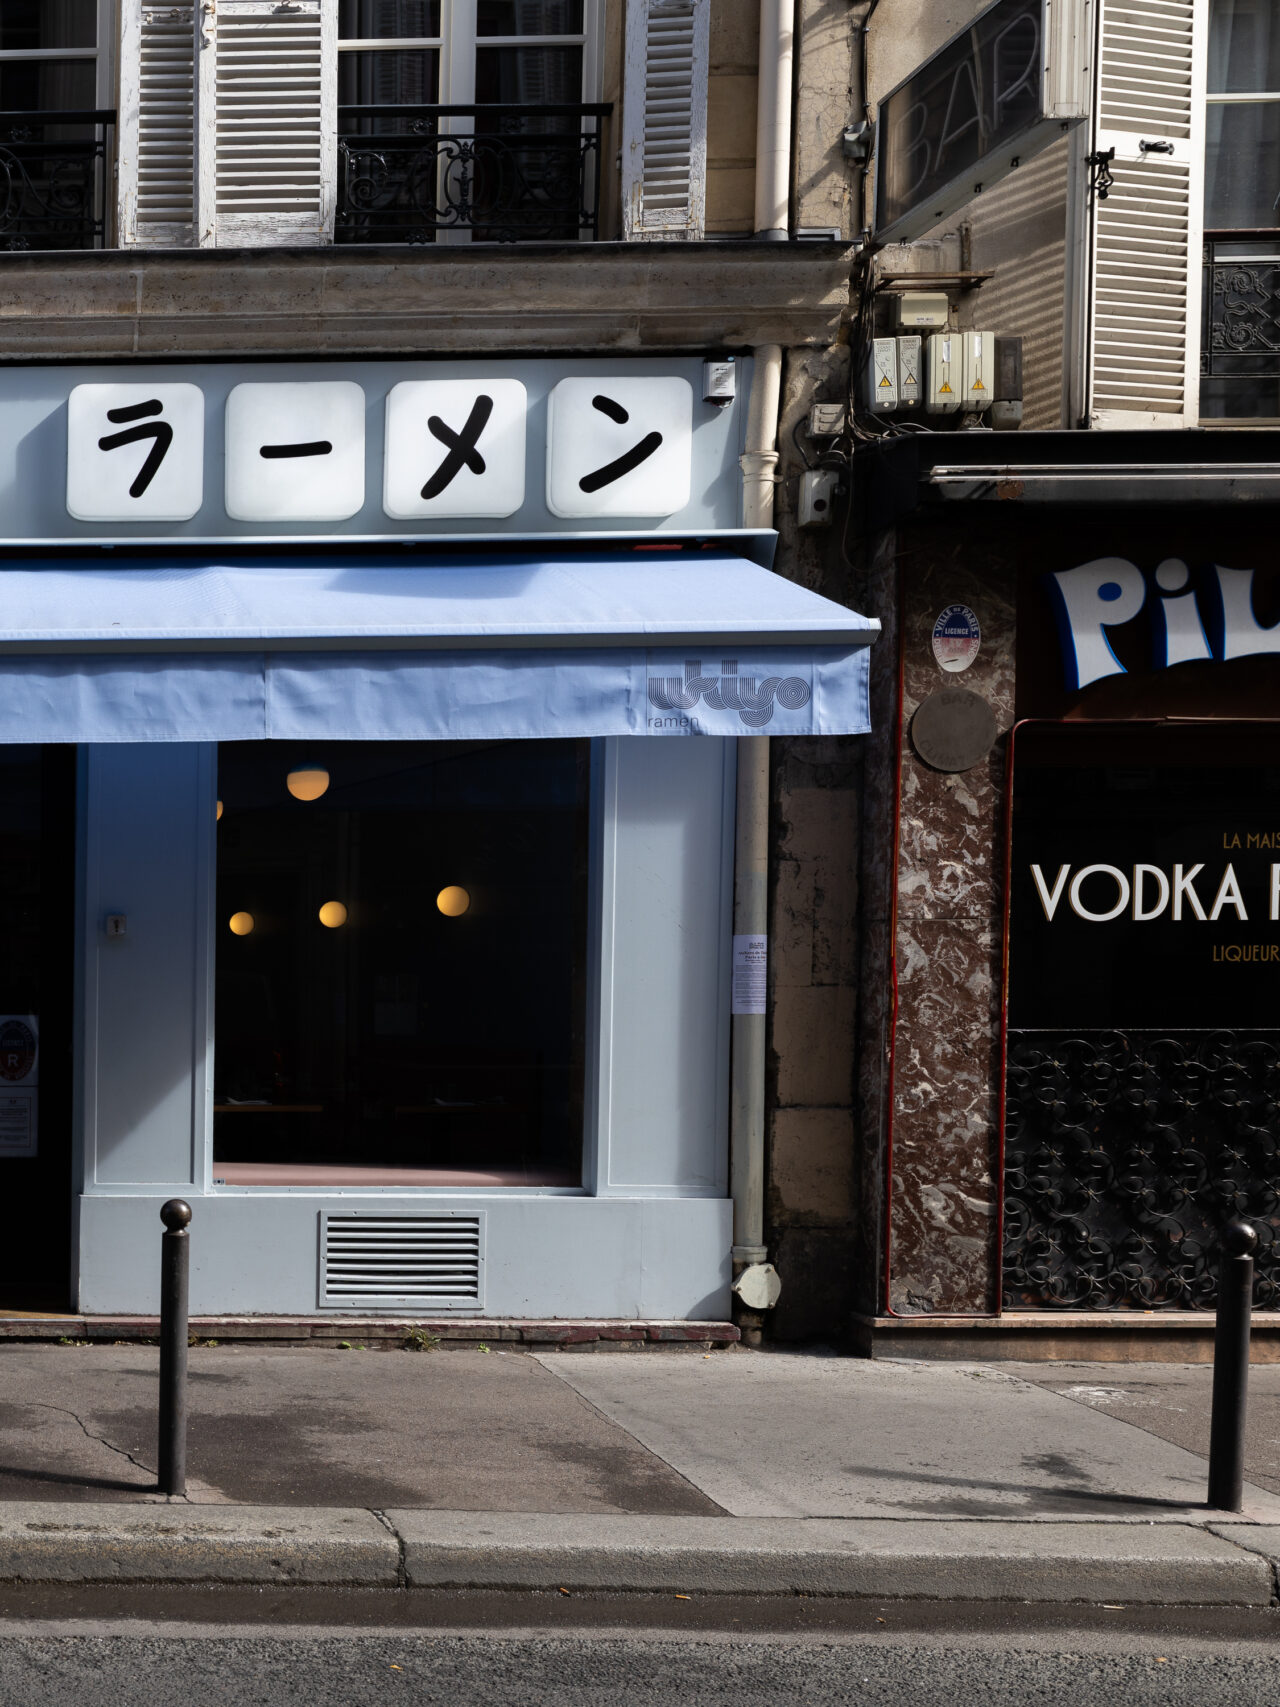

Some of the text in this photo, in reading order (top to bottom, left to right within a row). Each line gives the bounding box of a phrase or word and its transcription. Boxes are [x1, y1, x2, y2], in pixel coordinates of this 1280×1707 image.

[893, 12, 1038, 201] BAR
[97, 394, 663, 499] ラーメン
[935, 609, 953, 630] VILLE
[960, 608, 979, 632] PARIS
[648, 659, 811, 728] ukiyo
[647, 716, 699, 728] ramen
[1223, 832, 1242, 849] LA
[1029, 862, 1249, 922] VODKA
[7, 1053, 19, 1067] R
